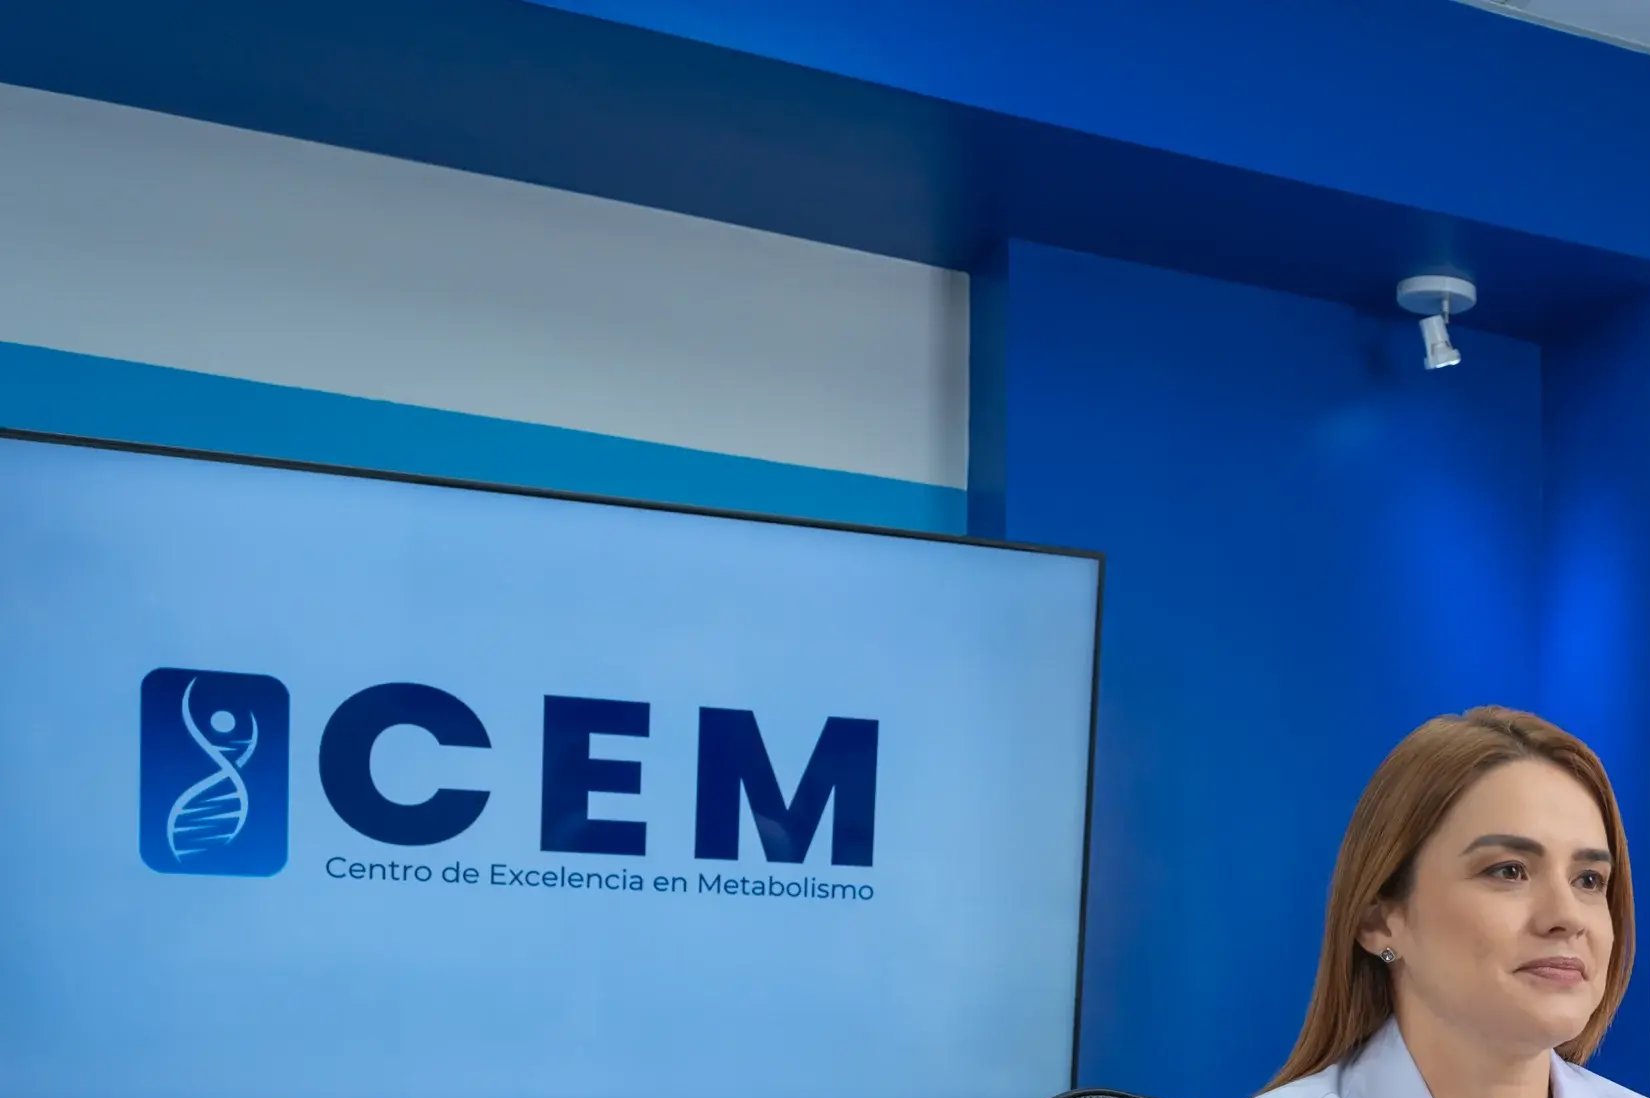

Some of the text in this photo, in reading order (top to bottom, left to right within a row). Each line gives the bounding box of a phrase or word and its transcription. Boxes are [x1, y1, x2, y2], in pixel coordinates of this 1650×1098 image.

[319, 682, 880, 867] CEM
[325, 856, 874, 901] Centro de Excelencia en Metabolismo
